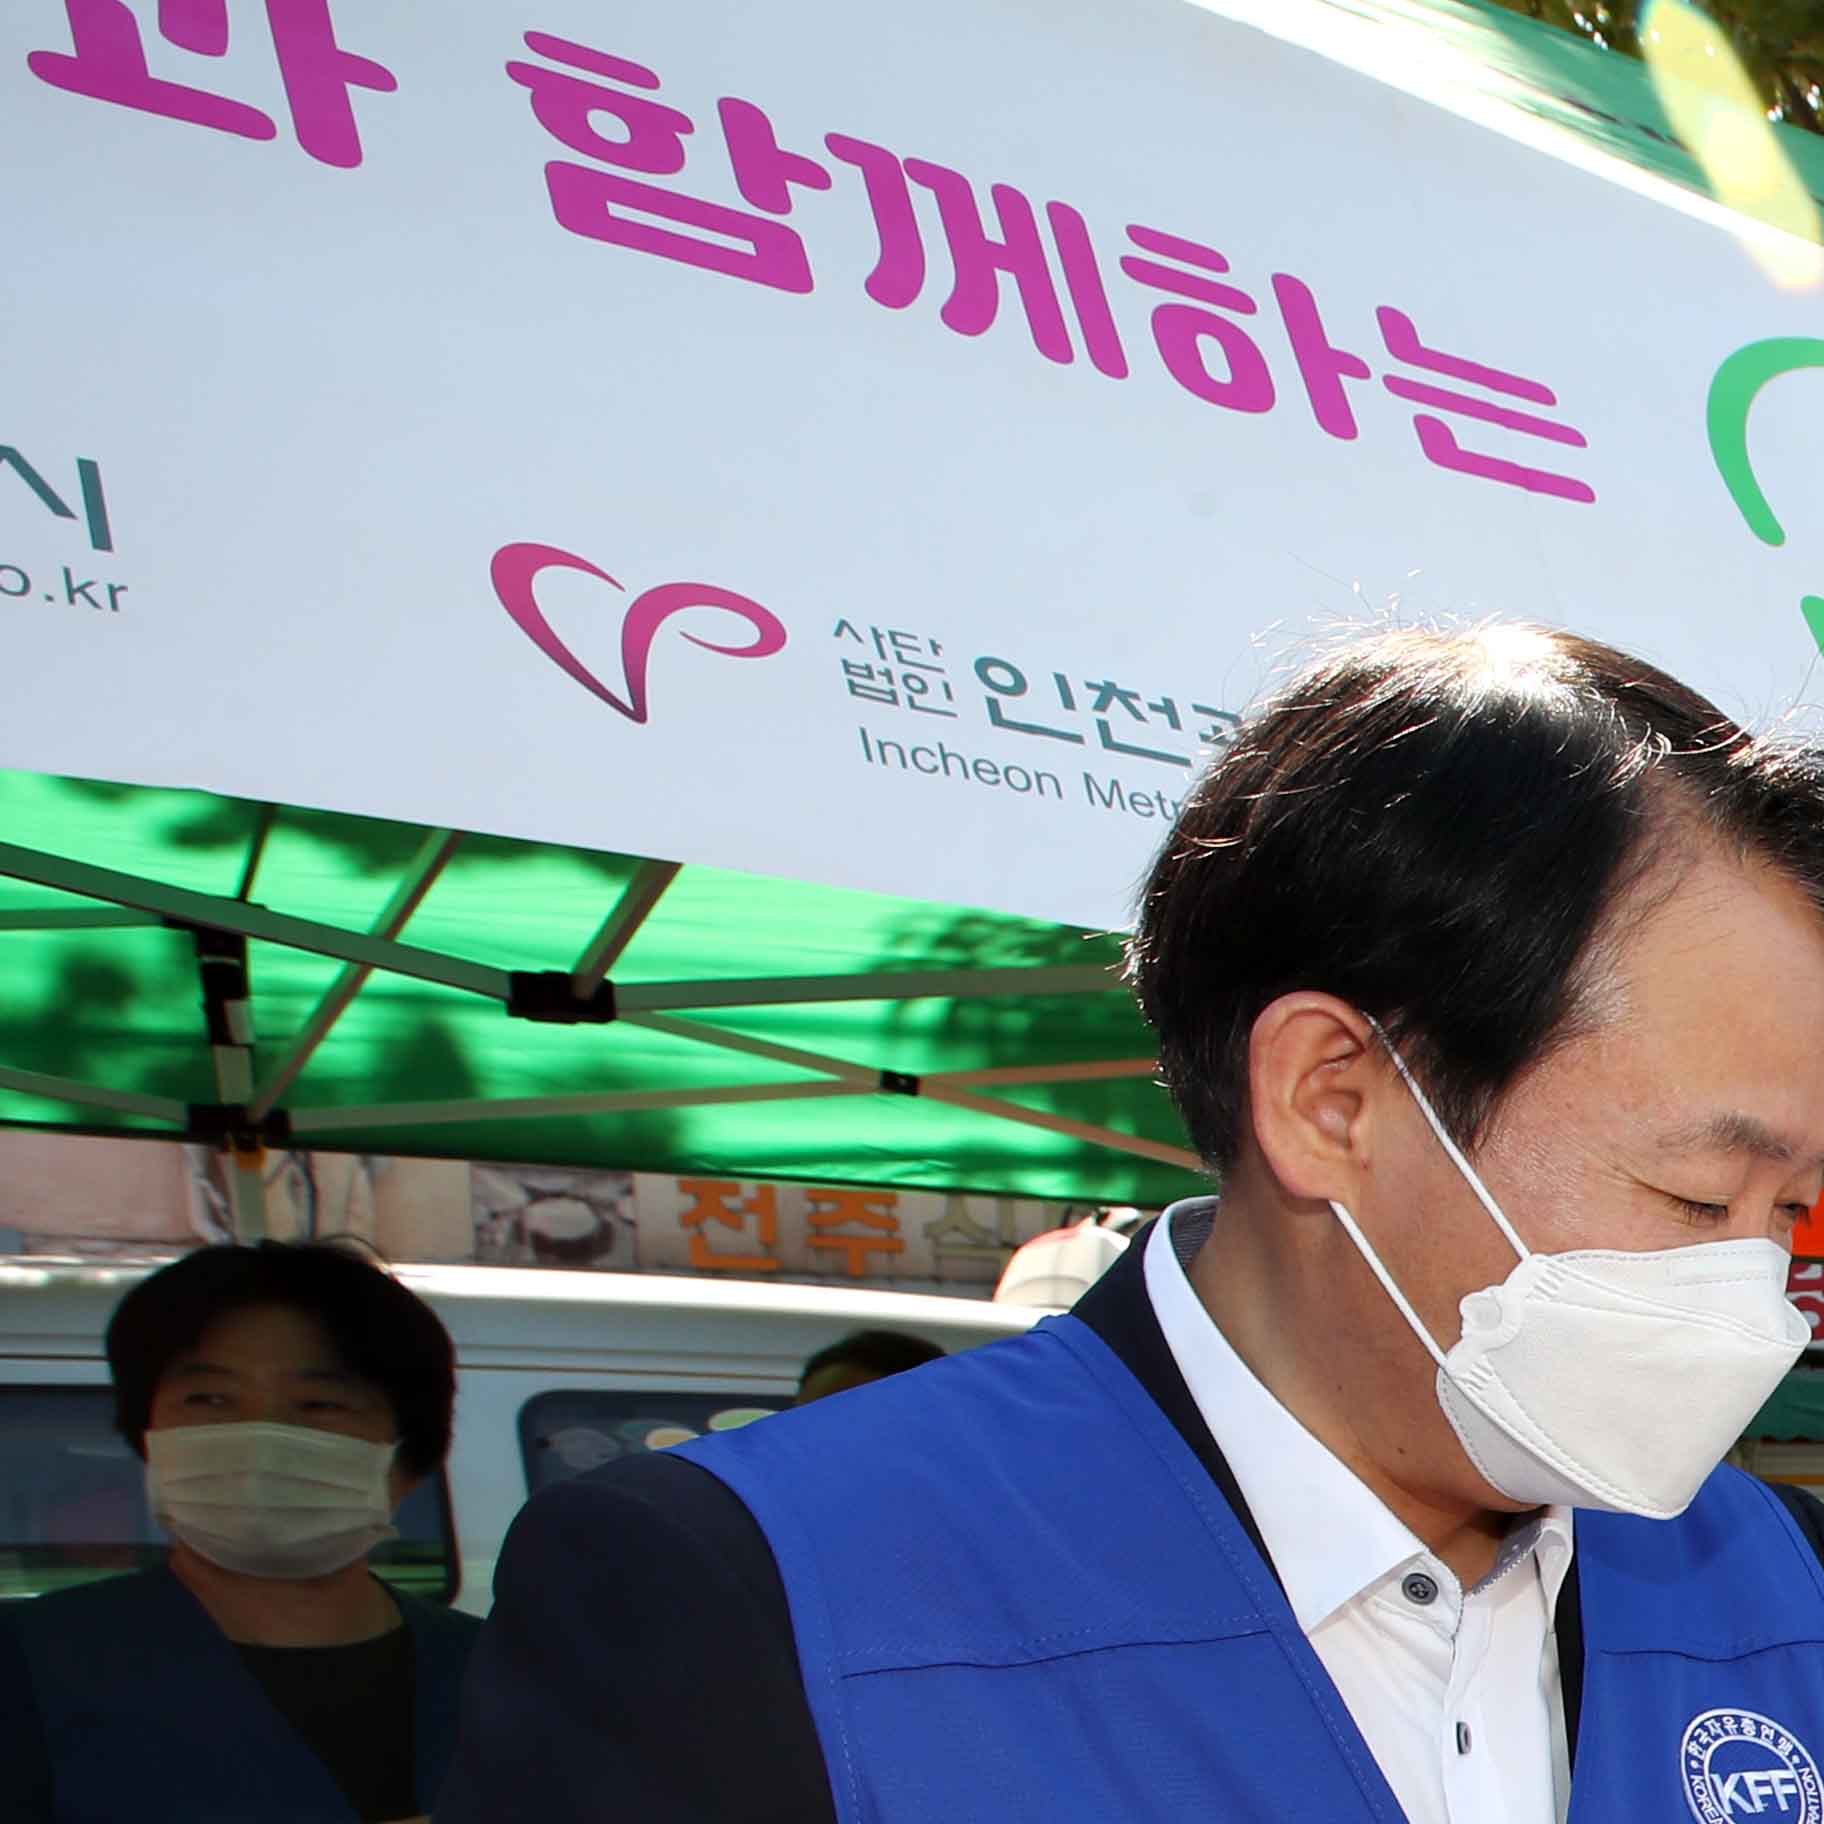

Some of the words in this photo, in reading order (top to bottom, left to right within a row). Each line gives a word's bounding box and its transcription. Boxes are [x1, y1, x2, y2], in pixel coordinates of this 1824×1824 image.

[505, 30, 1597, 504] 함께하는
[834, 618, 945, 674] 사단
[841, 658, 958, 718] 법인
[858, 726, 1063, 800] Incheon
[1709, 1768, 1798, 1815] KFF
